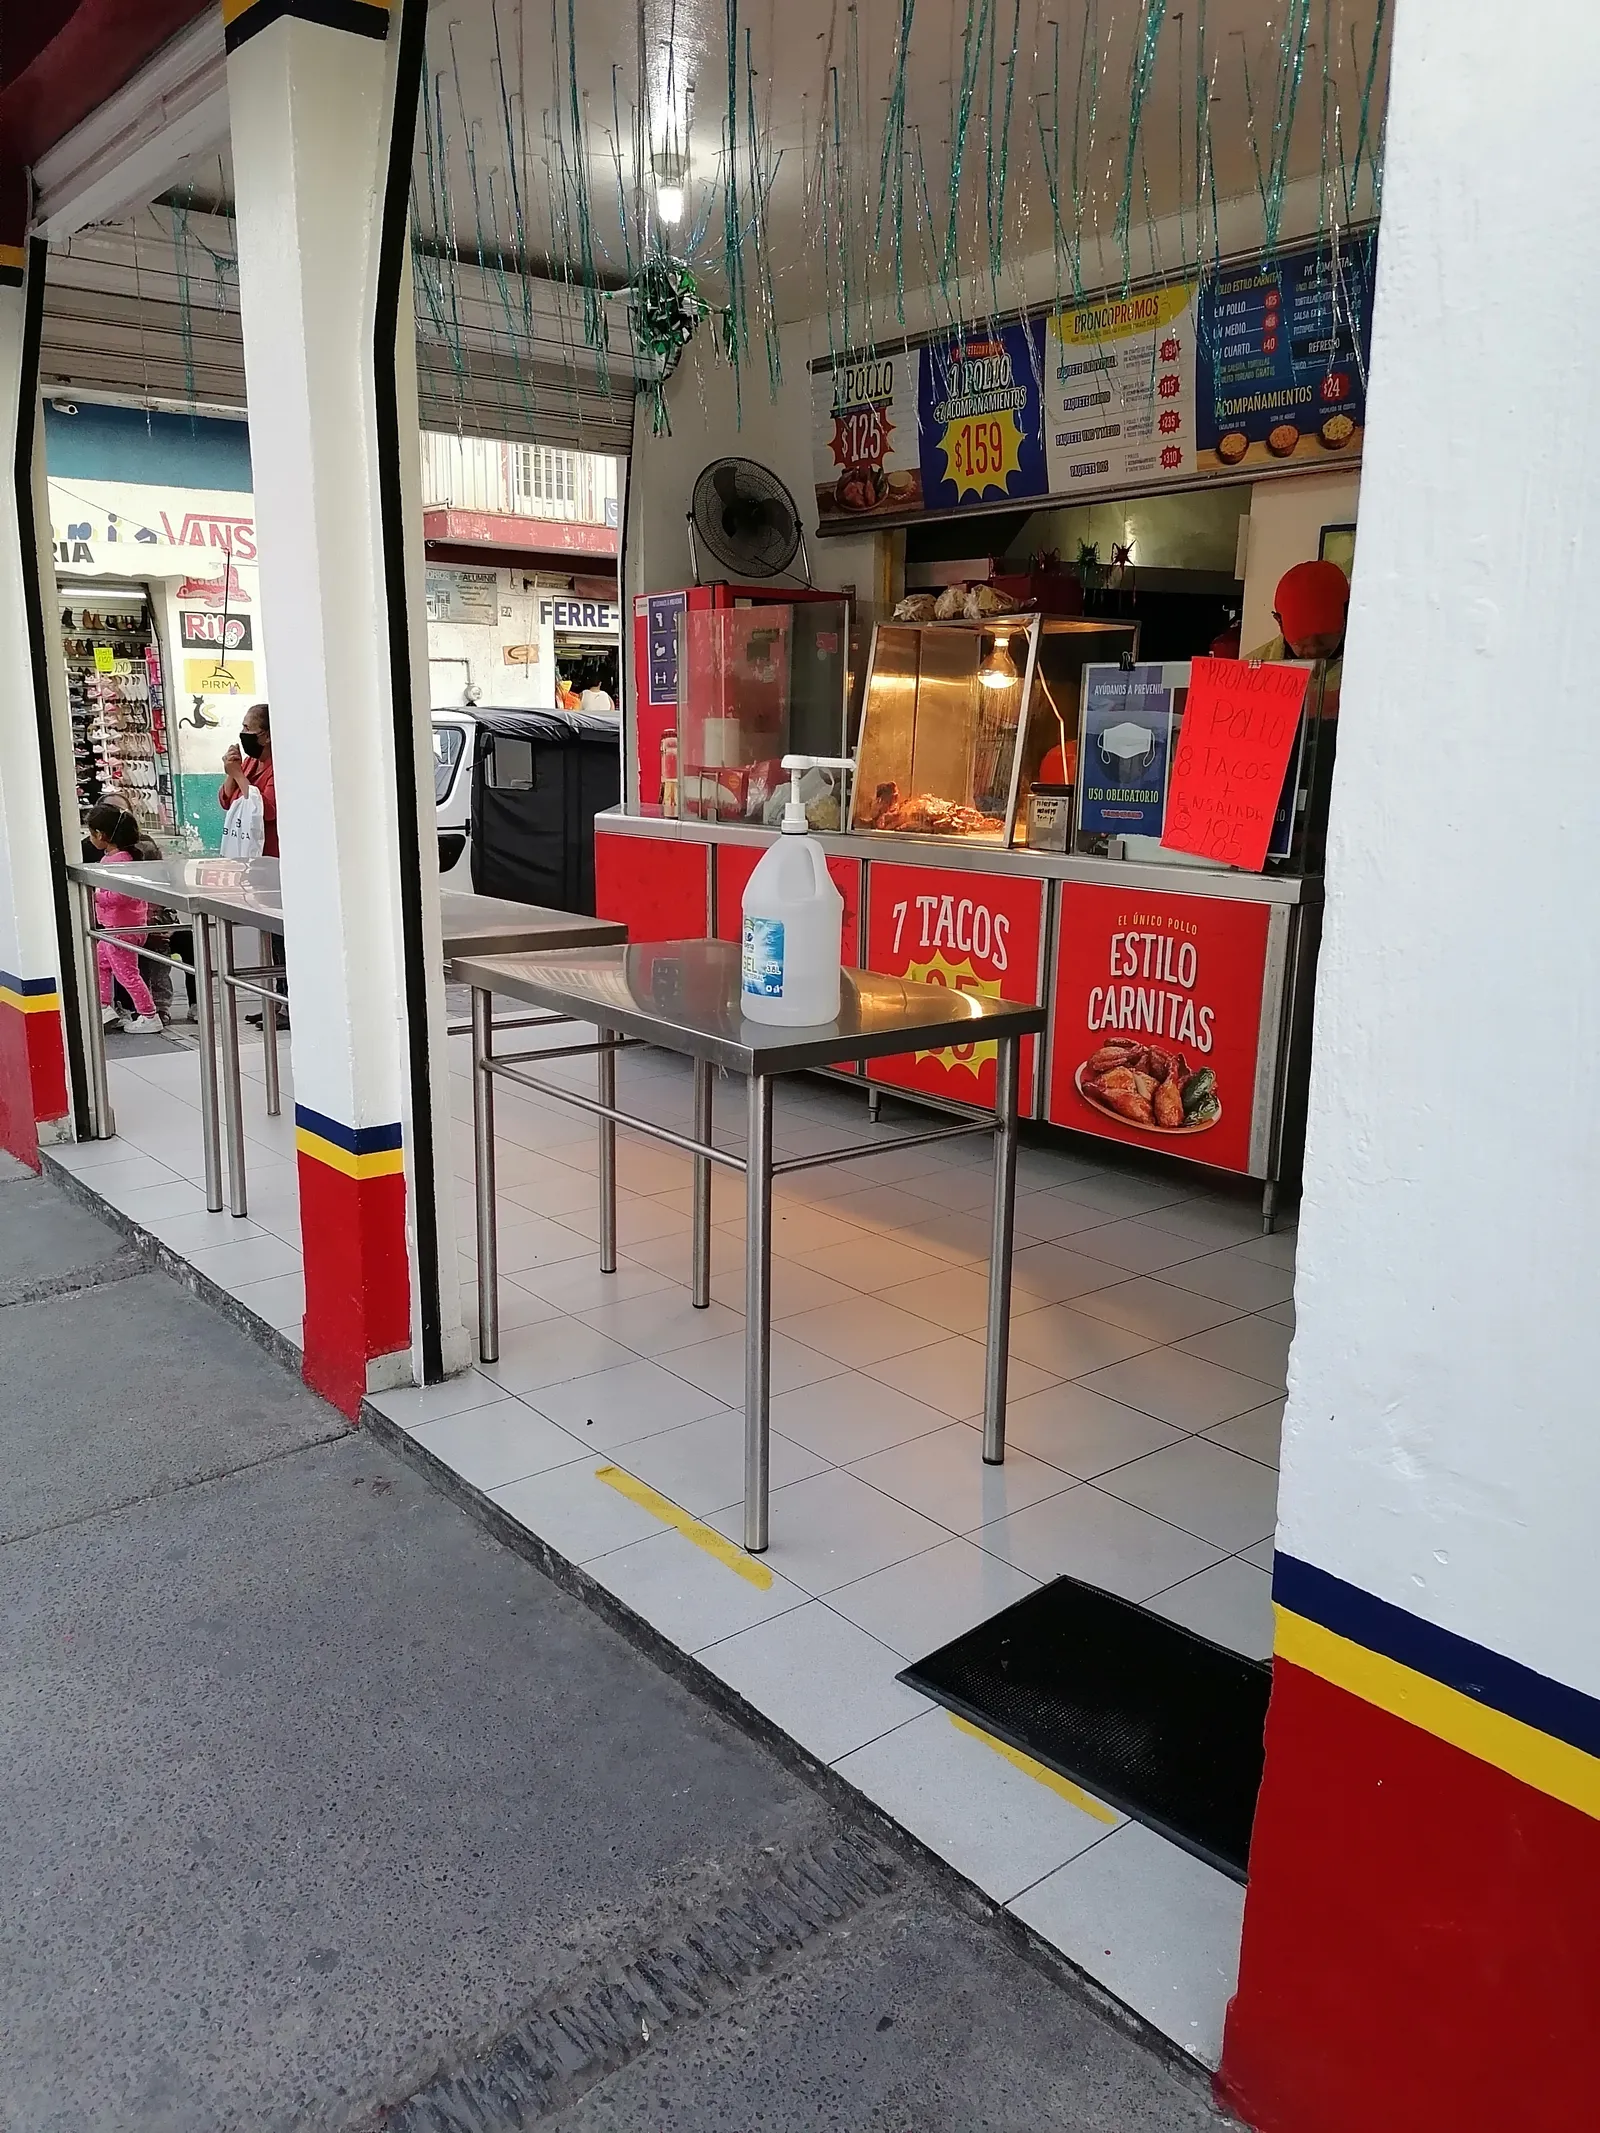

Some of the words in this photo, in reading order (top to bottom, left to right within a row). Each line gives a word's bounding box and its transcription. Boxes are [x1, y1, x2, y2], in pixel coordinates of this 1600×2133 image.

[1233, 278, 1253, 293] ESTILO
[1226, 300, 1246, 317] POLLO
[1225, 322, 1247, 338] MEDIO
[1224, 342, 1251, 359] CUARTO
[846, 361, 893, 403] POLLO
[963, 354, 1011, 394] POLLO
[1323, 378, 1341, 398] $24
[1064, 397, 1089, 411] PAQUETE
[841, 412, 881, 463] $125
[955, 420, 1002, 477] $159
[1070, 463, 1095, 477] PAQUETE
[160, 511, 257, 561] VANS
[202, 680, 241, 690] PIRMA
[1094, 681, 1127, 696] AYÚDANOS
[1127, 684, 1133, 695] A
[1177, 745, 1193, 777] 8
[1203, 746, 1271, 781] TACOS
[1088, 787, 1103, 801] USO
[1106, 788, 1159, 804] OBLIGATORIO
[892, 900, 908, 954] 7
[915, 894, 1010, 971] TACOS
[1118, 914, 1127, 926] EL
[1133, 912, 1162, 927] ÚNICO
[1168, 917, 1198, 936] POLLO
[1110, 931, 1197, 988] ESTILO
[1087, 985, 1215, 1053] CARNITAS
